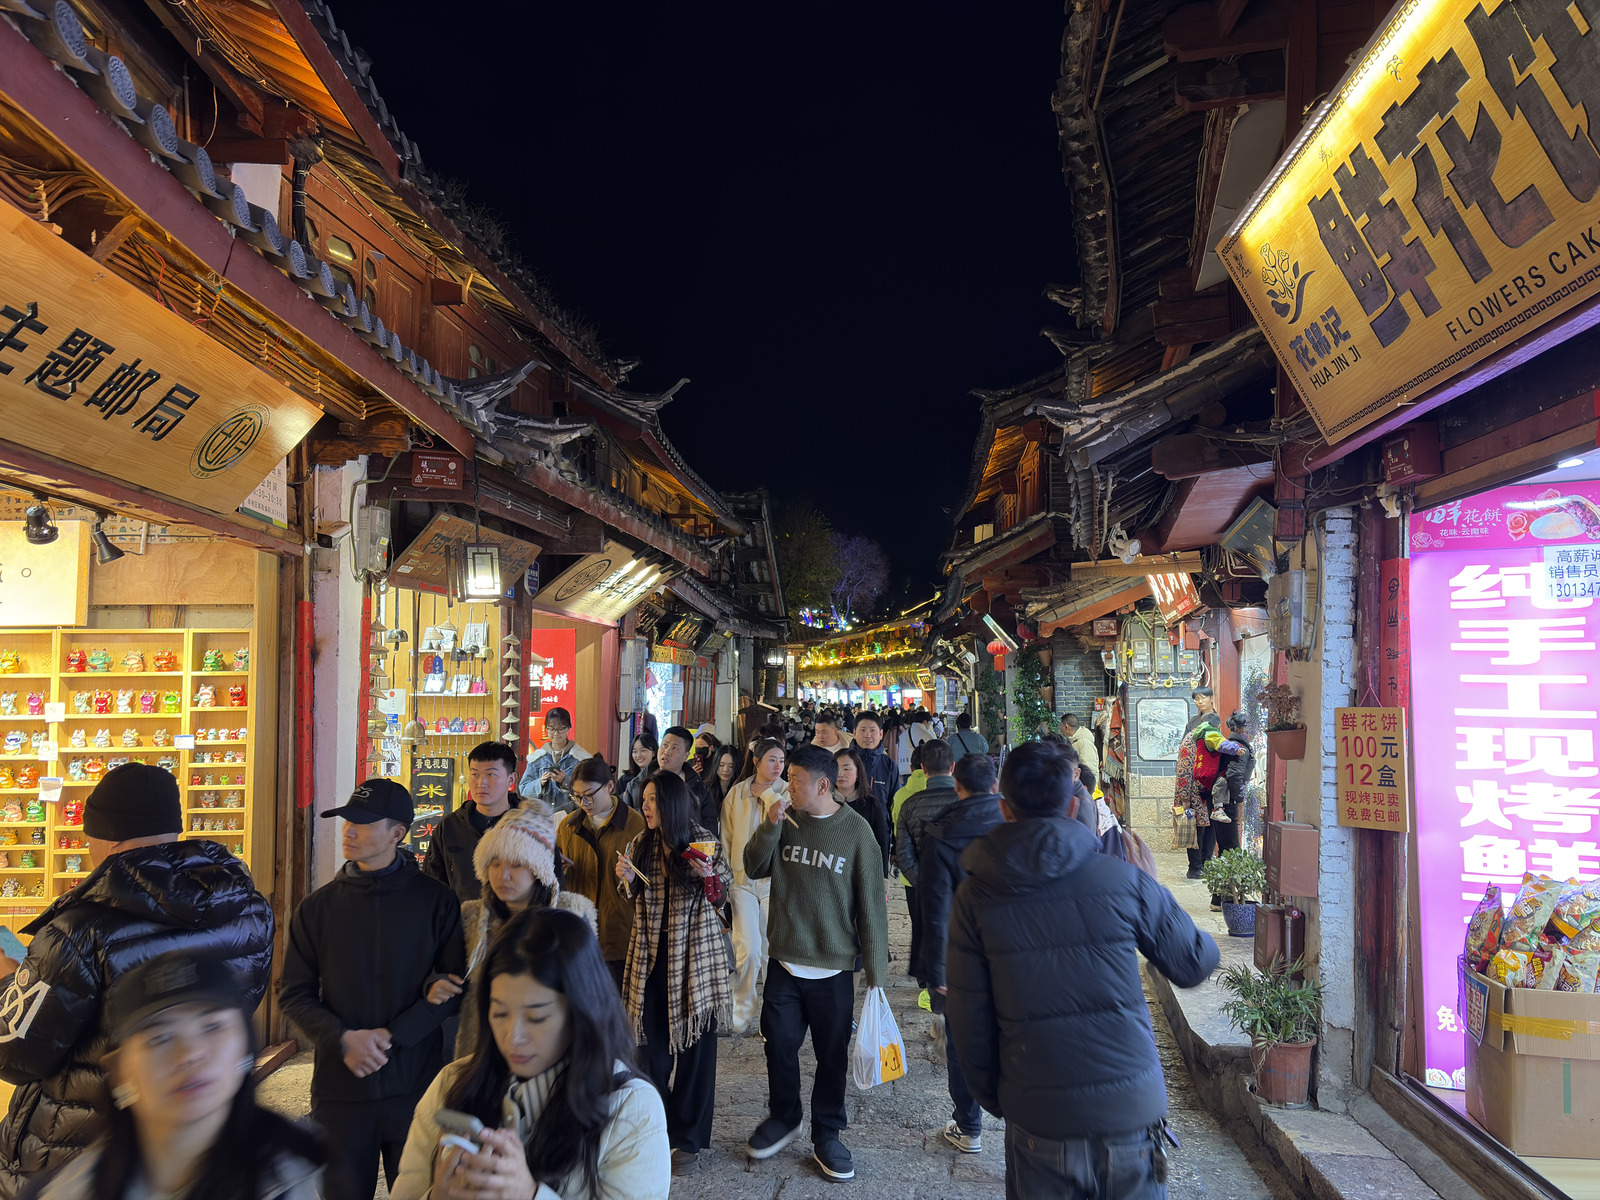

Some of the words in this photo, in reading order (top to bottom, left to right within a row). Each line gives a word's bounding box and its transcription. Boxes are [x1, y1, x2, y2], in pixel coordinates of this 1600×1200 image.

[1446, 265, 1546, 342] FLOWERS
[1548, 220, 1600, 275] CAK
[1289, 305, 1352, 372] 花锦记
[0, 301, 200, 441] 主题邮局
[1309, 366, 1335, 390] HUA
[1331, 353, 1350, 375] JIN
[1348, 344, 1362, 363] JI
[1548, 565, 1600, 579] 销售员
[1341, 713, 1398, 732] 鲜花饼
[1341, 735, 1399, 759] 100元
[1344, 763, 1398, 788] 12盒
[1345, 790, 1400, 808] 现烤现卖
[1346, 806, 1401, 824] 免费包邮
[781, 844, 847, 875] CELINE
